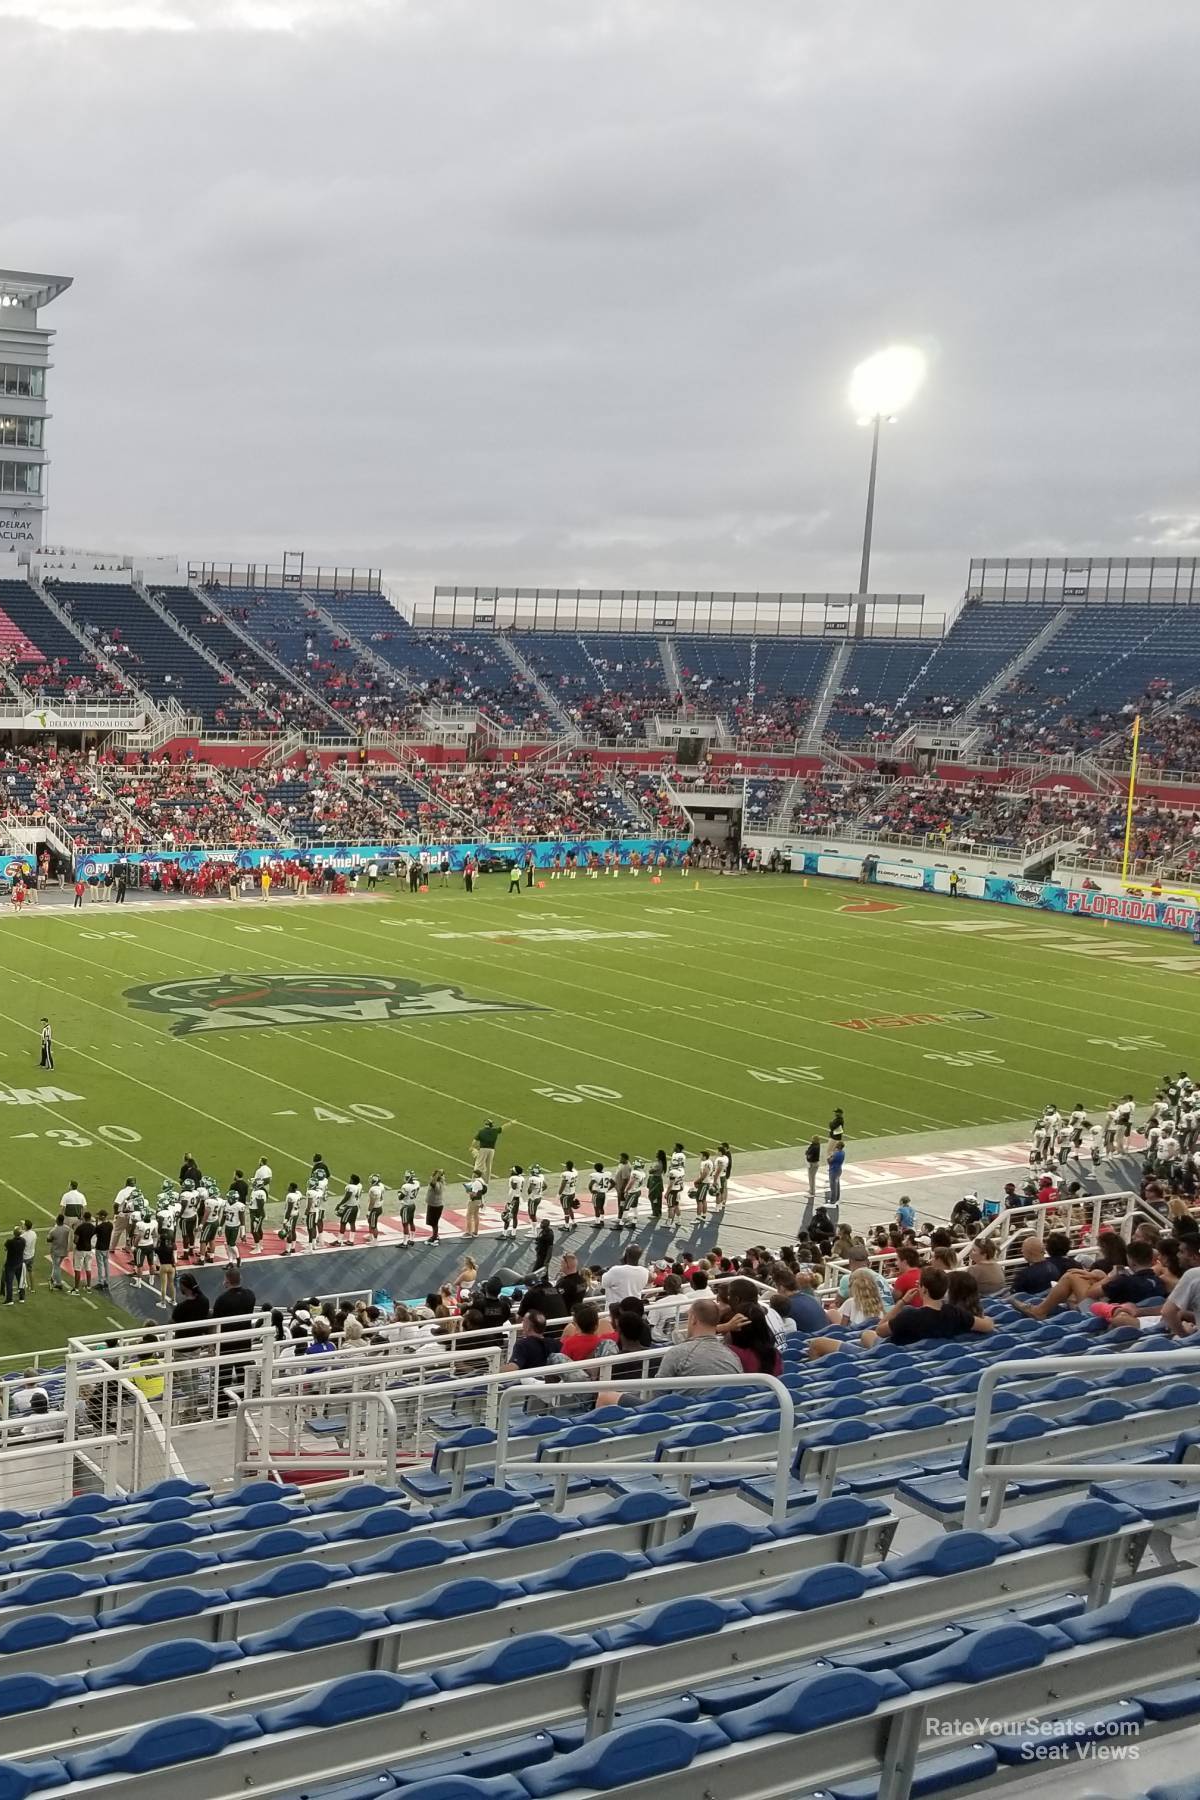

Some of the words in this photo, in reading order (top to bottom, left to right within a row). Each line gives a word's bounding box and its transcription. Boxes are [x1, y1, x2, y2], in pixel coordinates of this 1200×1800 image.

[0, 520, 32, 529] DELRAY
[50, 720, 78, 728] DELRAY
[79, 720, 114, 728] HYUNDAI
[114, 720, 134, 728] DECK
[419, 851, 450, 866] Field
[1066, 892, 1157, 923] FLORIDA
[170, 989, 540, 1032] FAU
[531, 1083, 624, 1104] 50
[313, 1102, 396, 1124] 40
[44, 1124, 142, 1148] 30
